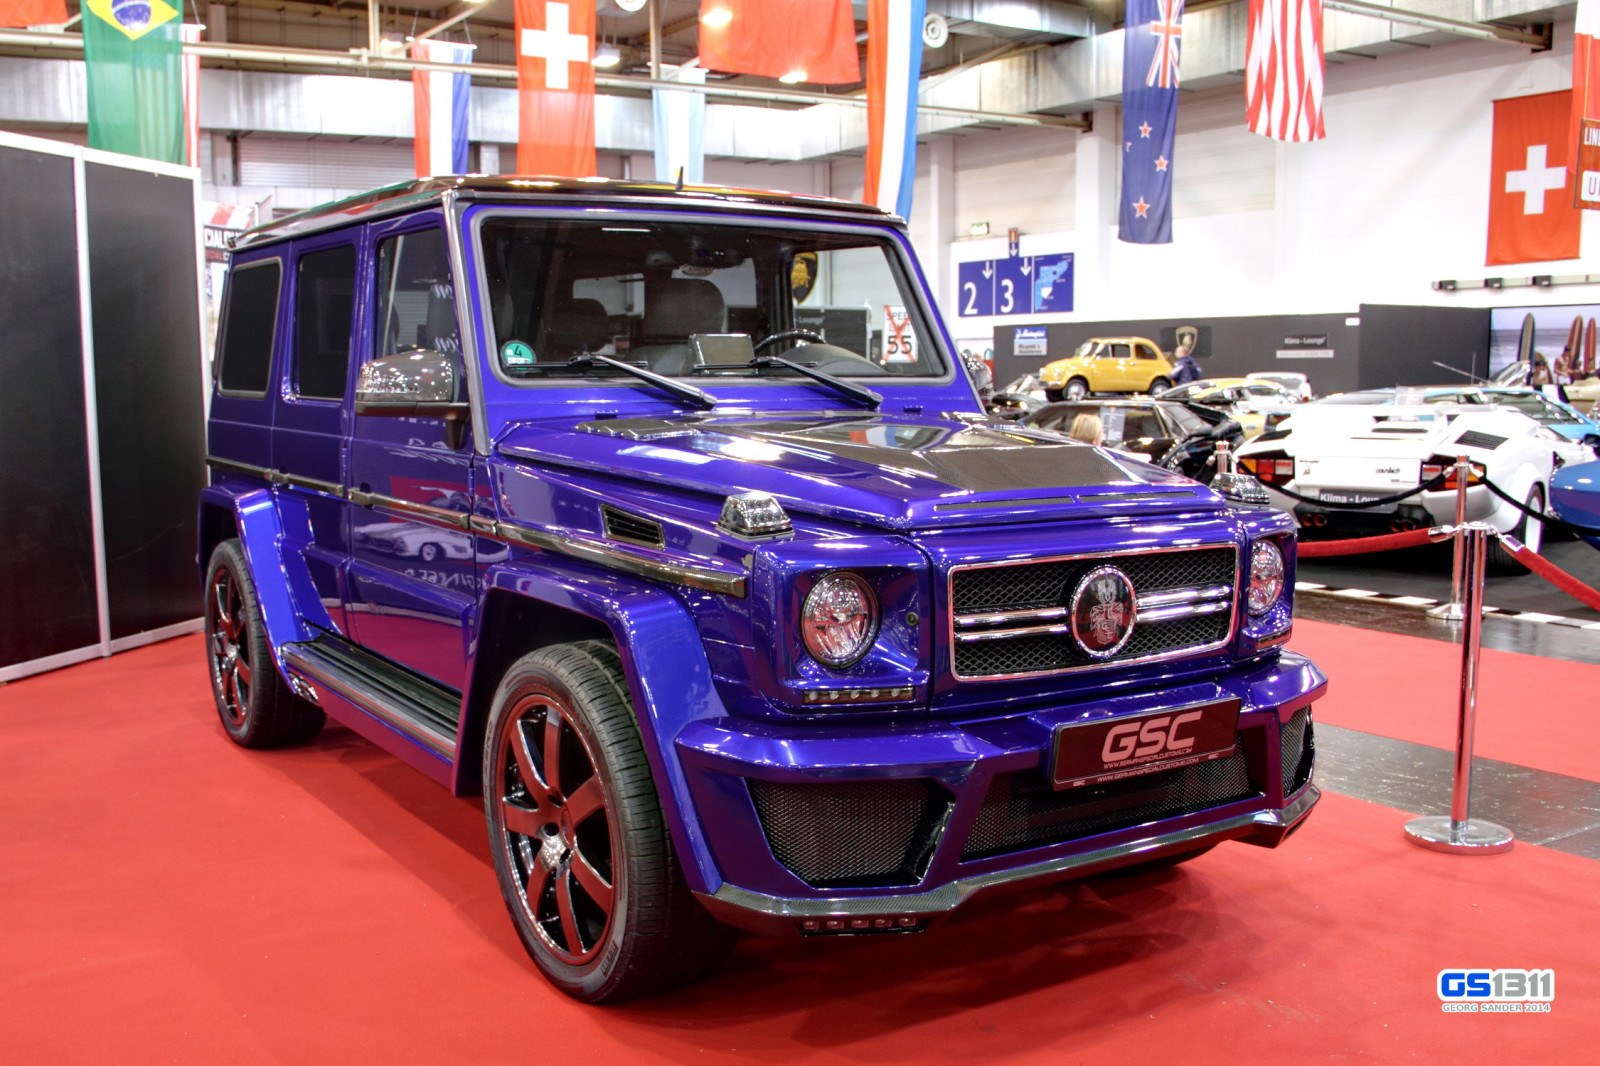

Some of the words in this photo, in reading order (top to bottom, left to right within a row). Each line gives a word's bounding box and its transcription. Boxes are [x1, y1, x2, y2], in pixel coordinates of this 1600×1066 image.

[1584, 127, 1600, 146] LIN
[1589, 176, 1600, 196] U
[963, 281, 978, 315] 2
[1000, 278, 1014, 313] 3
[886, 311, 910, 321] SPEE
[889, 323, 911, 332] LIT
[514, 344, 523, 357] 4
[887, 335, 912, 354] 55
[1320, 493, 1347, 503] Klima
[1101, 710, 1202, 763] GSC
